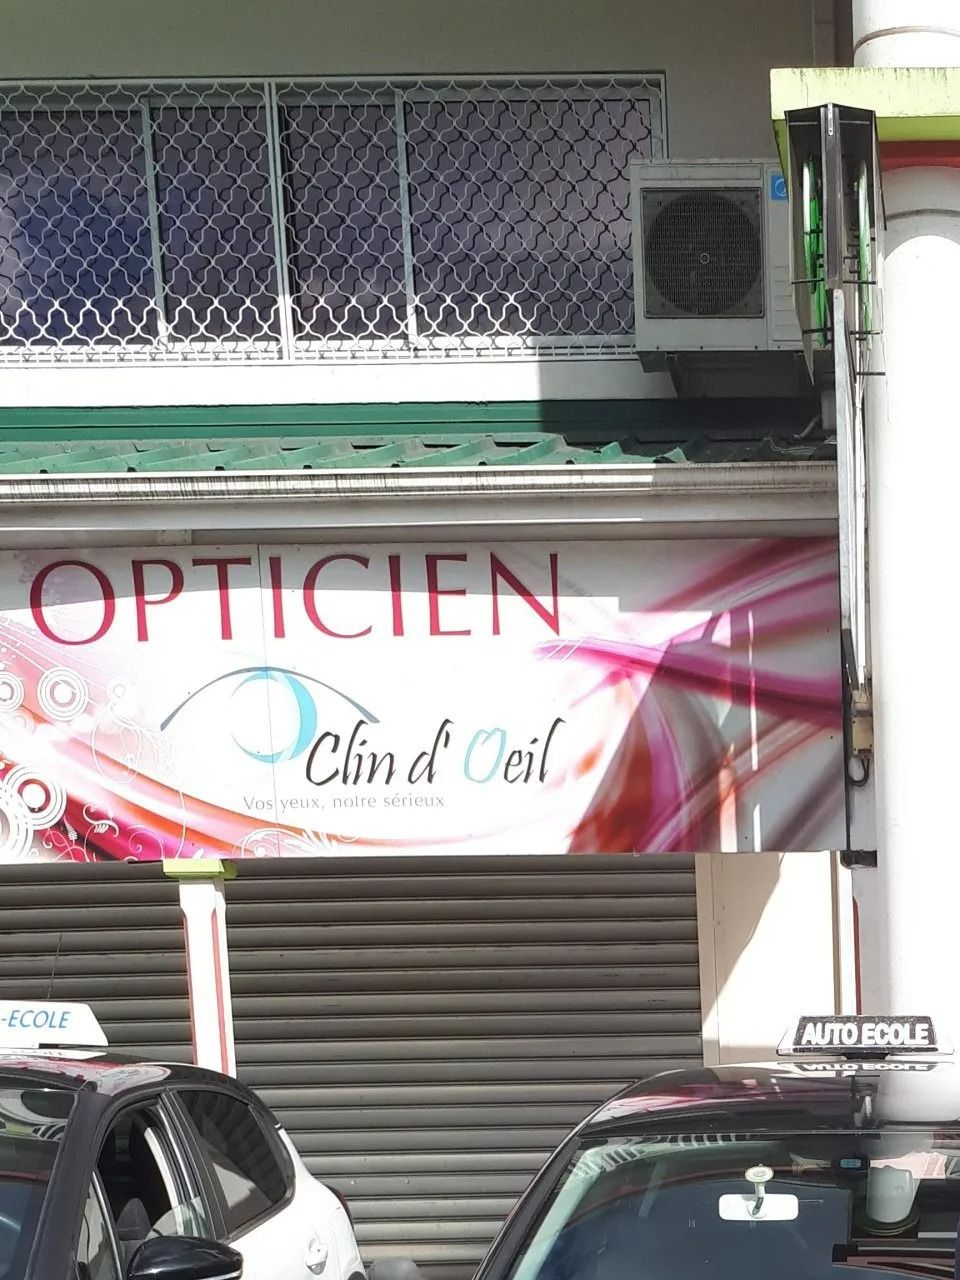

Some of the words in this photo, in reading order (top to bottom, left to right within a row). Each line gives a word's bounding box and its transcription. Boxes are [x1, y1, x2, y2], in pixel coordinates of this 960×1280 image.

[29, 552, 562, 648] OPTICIEN
[305, 719, 396, 786] Clin
[464, 717, 566, 783] Oeil
[243, 794, 274, 811] Vos
[279, 796, 325, 813] yeux,
[333, 794, 377, 809] notre
[383, 793, 445, 808] sérieux
[801, 1022, 858, 1046] AUTO
[862, 1022, 930, 1046] ECOLE
